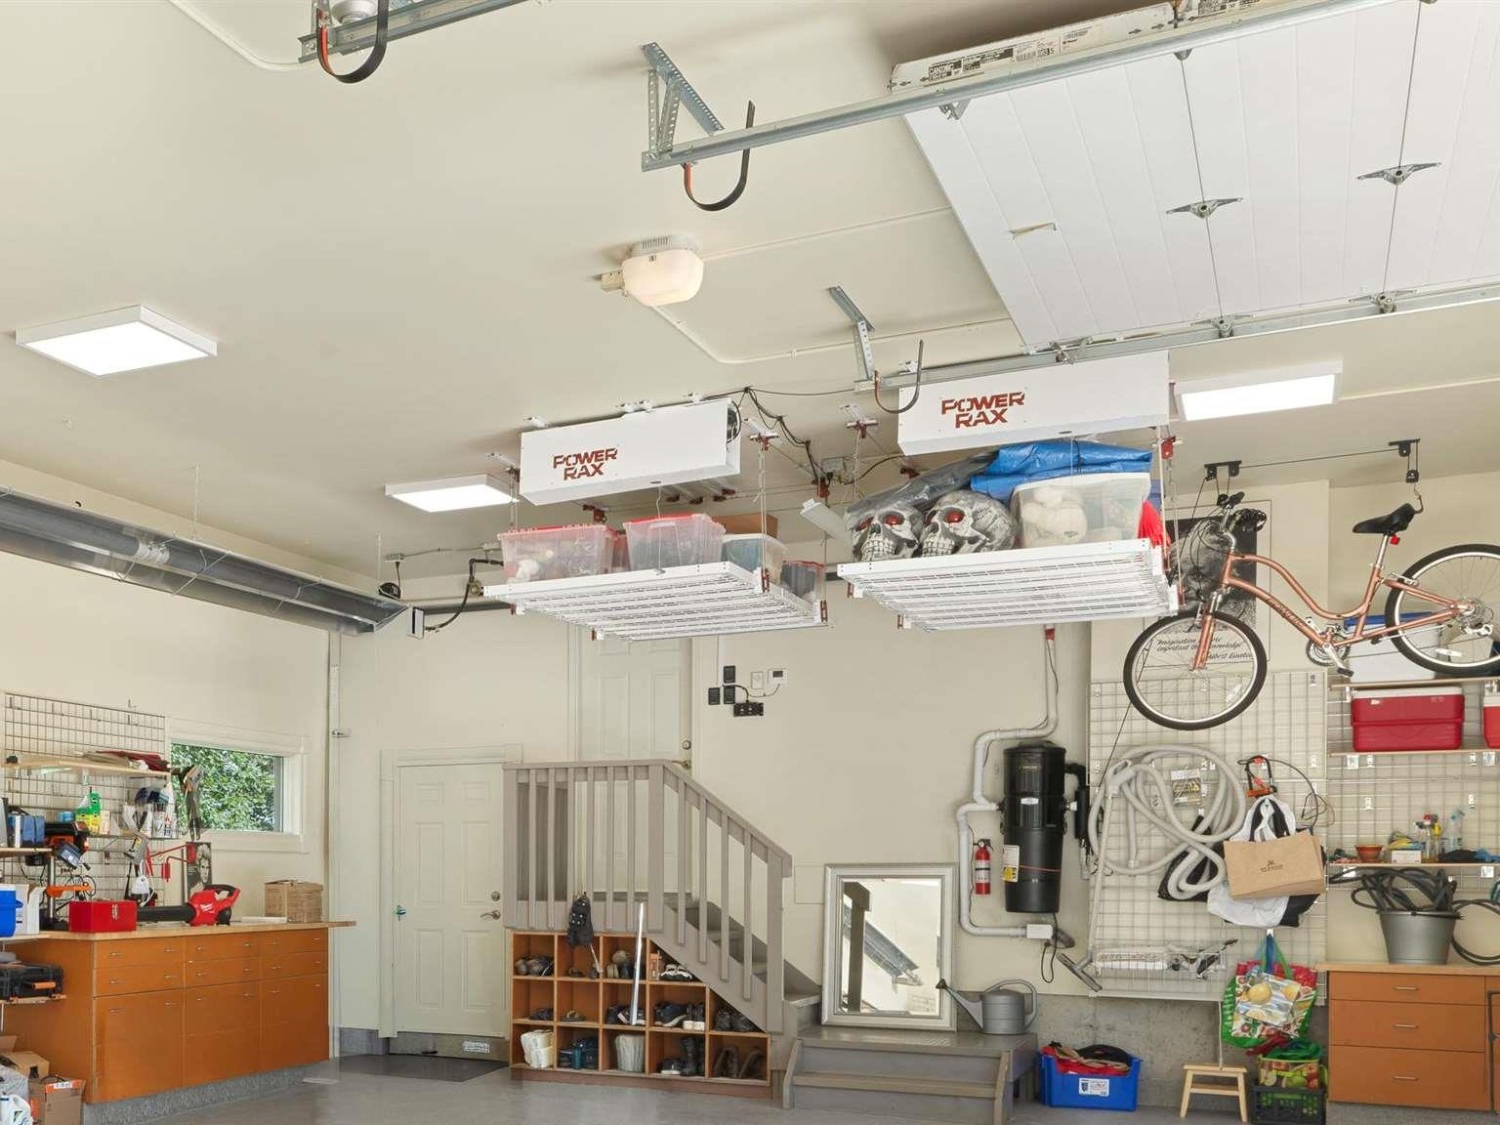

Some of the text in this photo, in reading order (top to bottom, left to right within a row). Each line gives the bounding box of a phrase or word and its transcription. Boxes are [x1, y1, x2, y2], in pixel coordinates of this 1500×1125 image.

[942, 392, 1025, 414] POWER
[955, 408, 1008, 429] RAX
[553, 447, 618, 469] POWER
[563, 462, 604, 481] RAX
